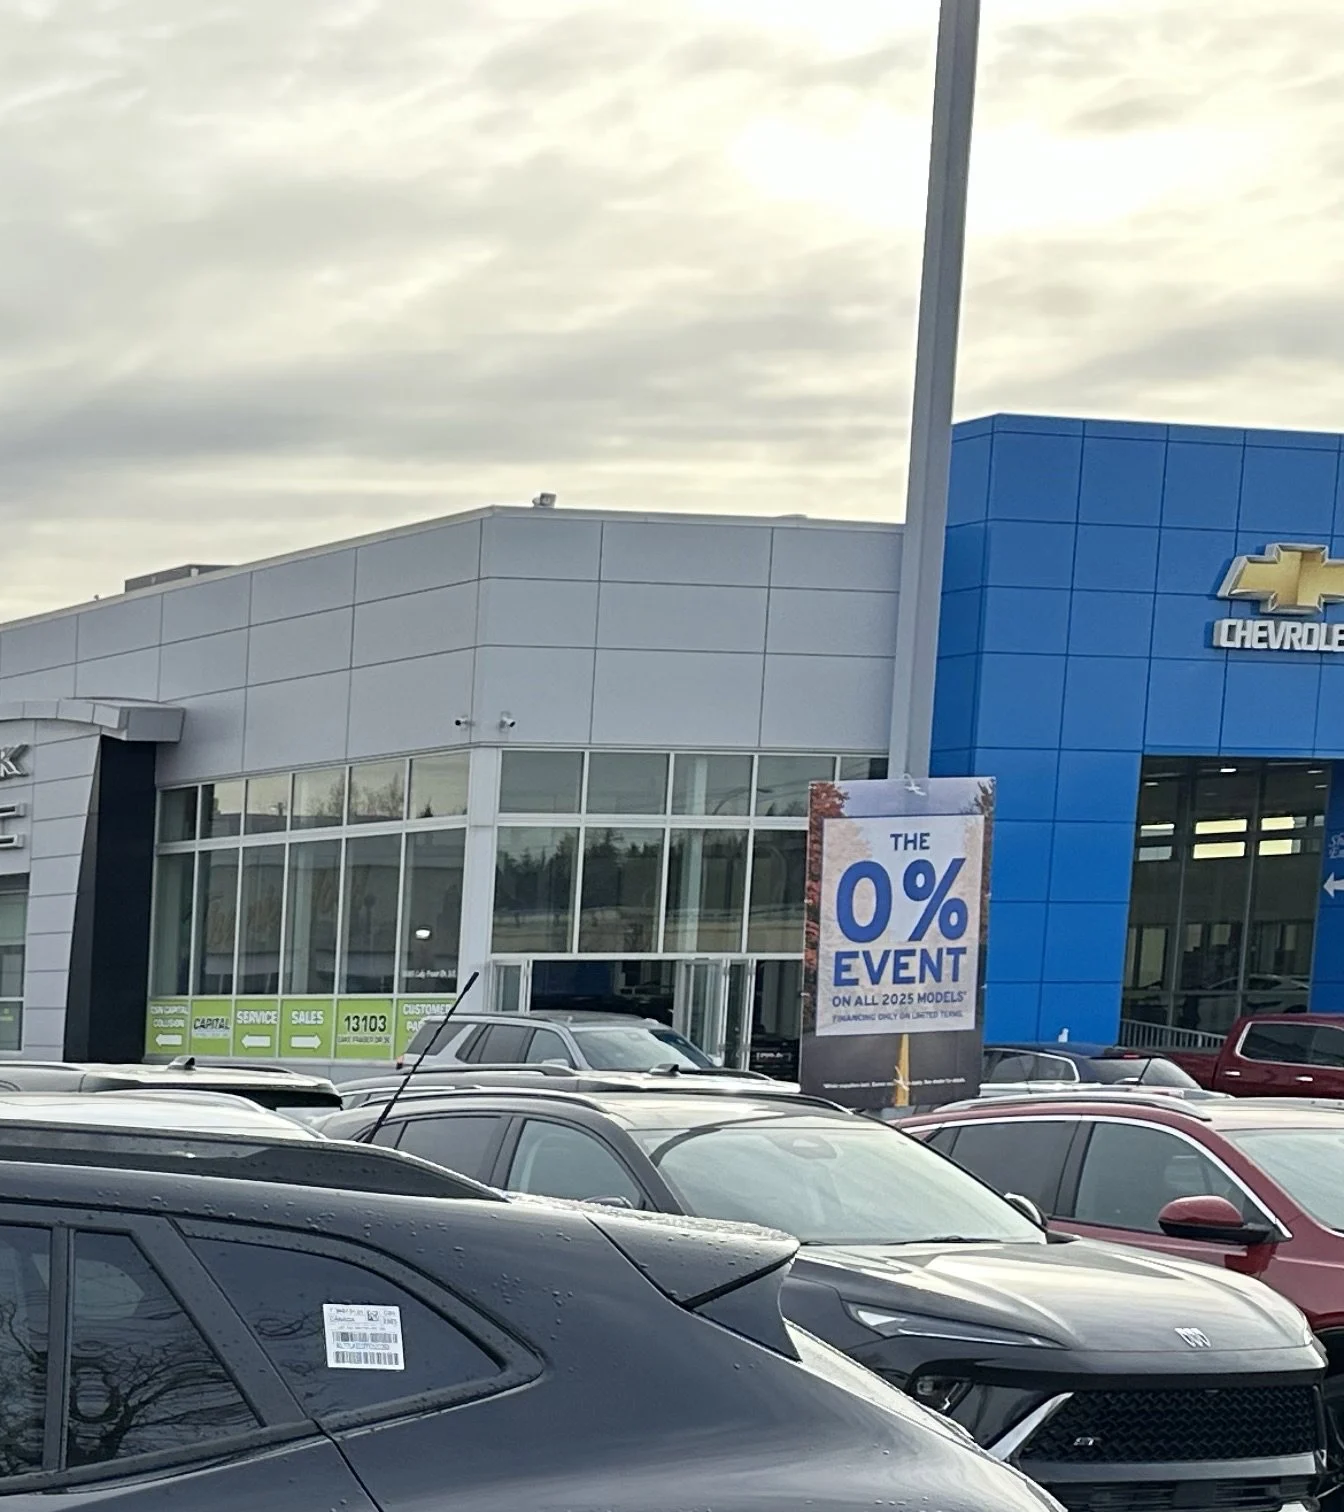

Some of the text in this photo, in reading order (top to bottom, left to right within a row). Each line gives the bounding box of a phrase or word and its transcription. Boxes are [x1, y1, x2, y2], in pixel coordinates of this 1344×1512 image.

[890, 832, 930, 851] THE
[836, 857, 968, 943] 0%
[833, 947, 968, 988] EVENT
[832, 995, 851, 1008] ON
[854, 994, 879, 1007] ALL
[882, 993, 914, 1006] 2025
[193, 1017, 231, 1031] CAPITAL
[236, 1010, 278, 1025] SERVICE
[291, 1010, 324, 1025] SALES
[344, 1014, 387, 1032] 13103
